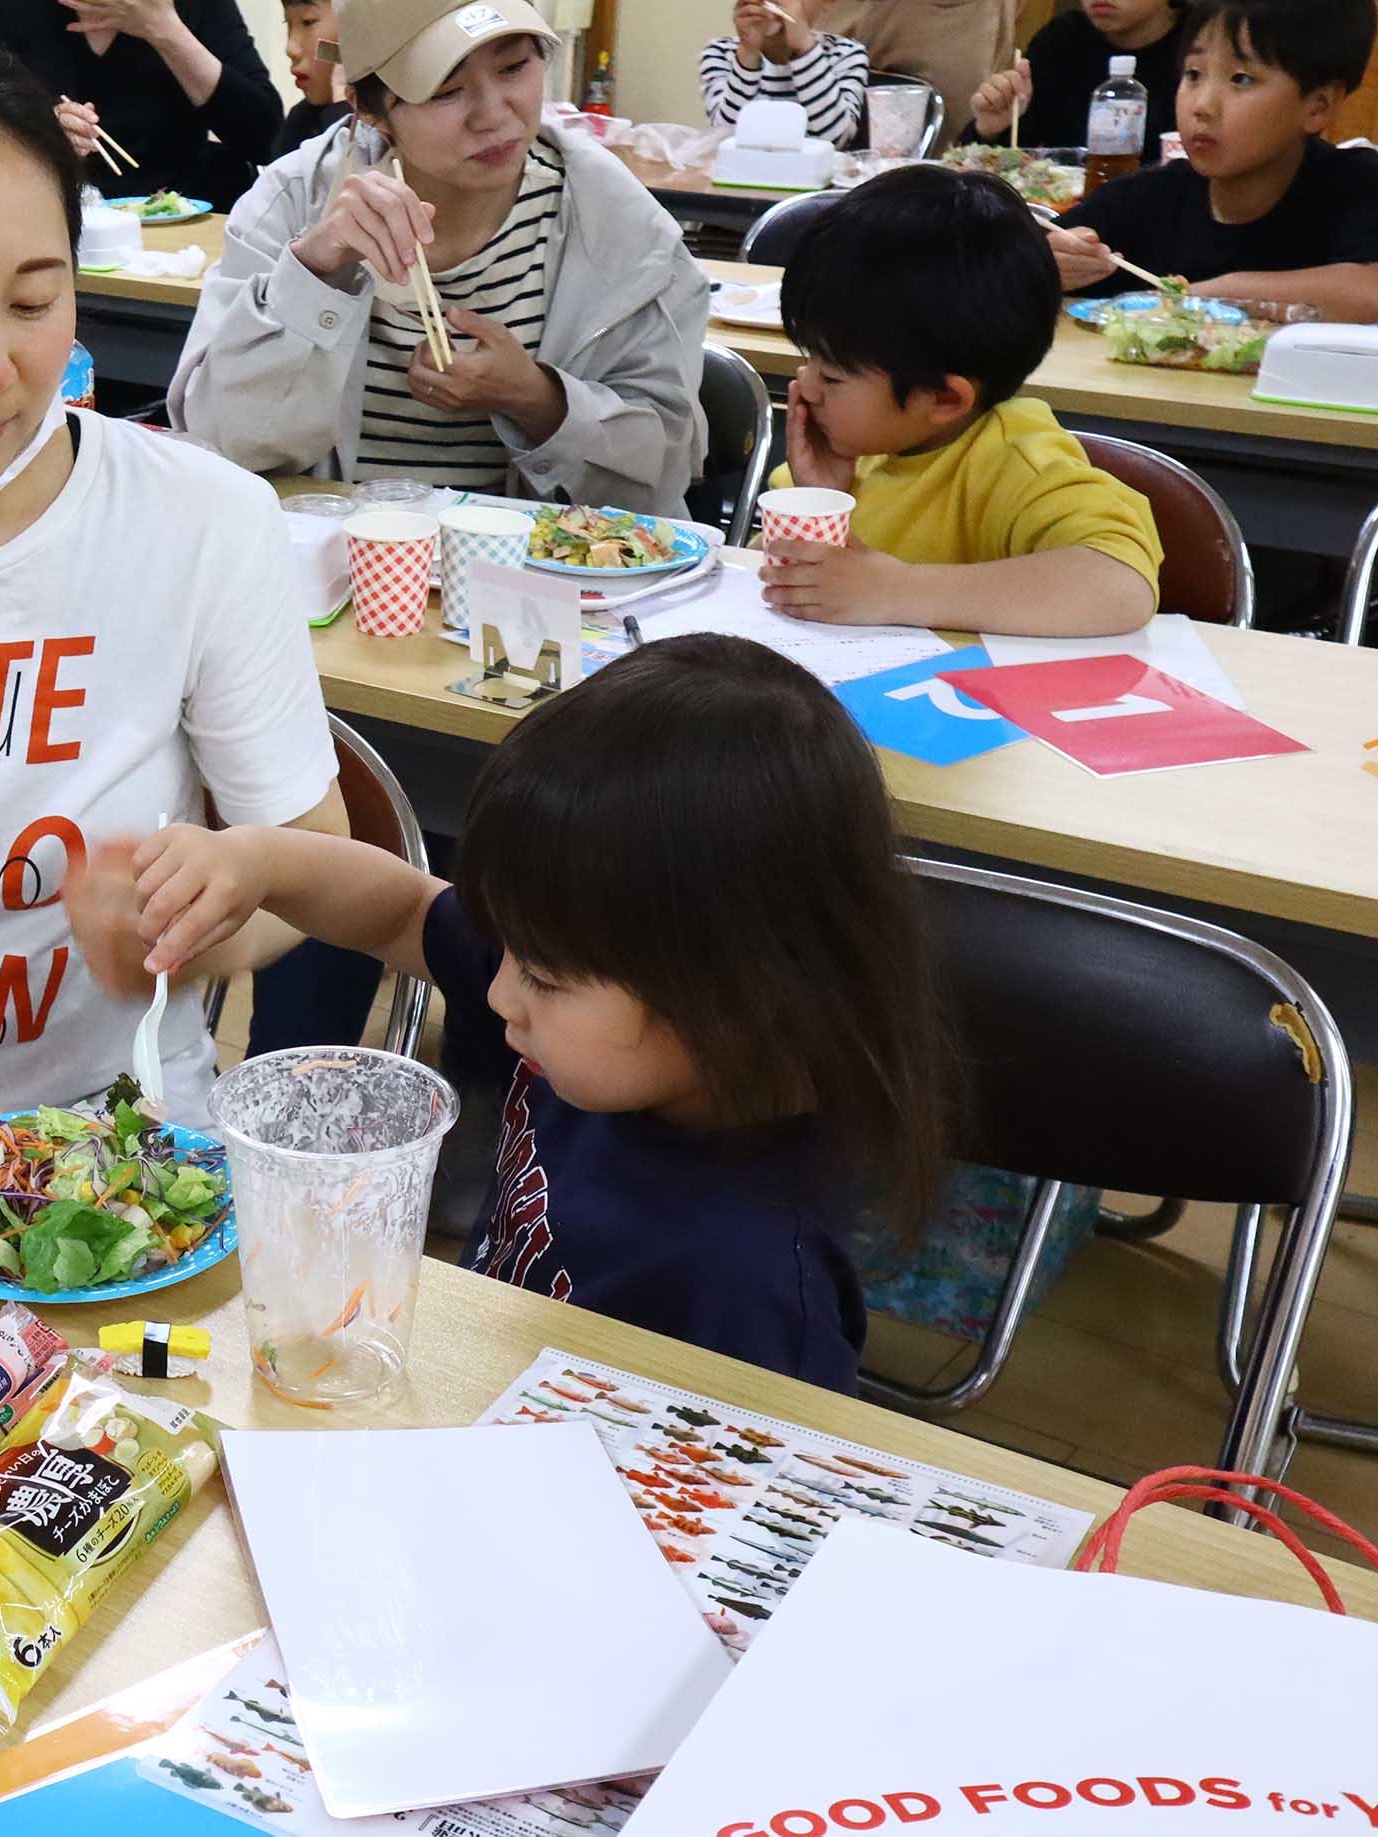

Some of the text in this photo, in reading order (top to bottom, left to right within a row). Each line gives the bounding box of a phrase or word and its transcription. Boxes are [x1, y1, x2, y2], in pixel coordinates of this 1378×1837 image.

[1050, 695, 1174, 722] 1
[52, 1474, 120, 1543] チーズかまぼこ
[13, 1625, 62, 1669] 6本入
[958, 1776, 1252, 1814] FOODS
[1266, 1791, 1340, 1819] for
